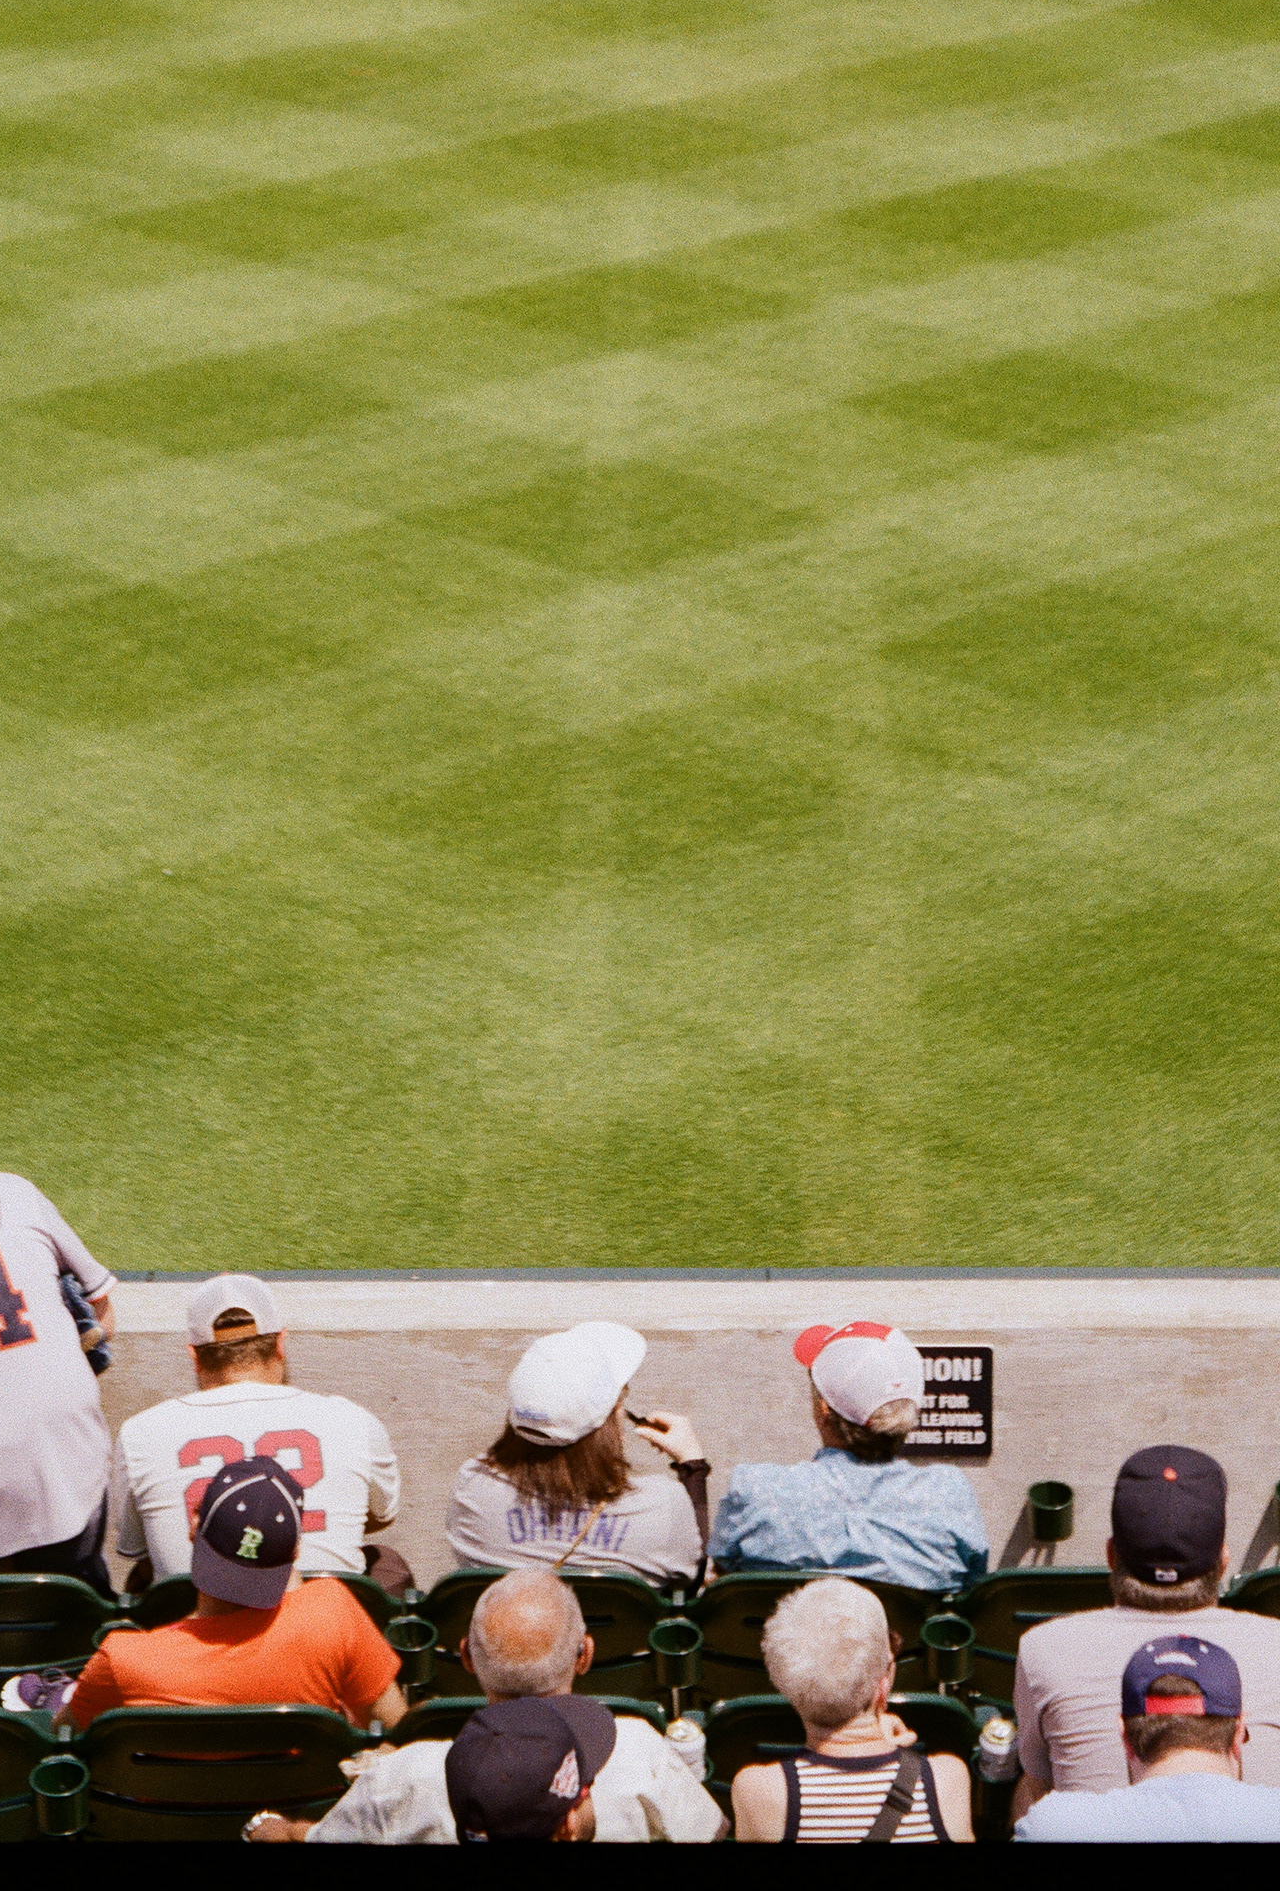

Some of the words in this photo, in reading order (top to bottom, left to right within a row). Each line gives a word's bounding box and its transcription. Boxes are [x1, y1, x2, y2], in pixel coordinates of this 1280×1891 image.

[923, 1357, 982, 1381] ION!
[921, 1413, 984, 1427] LEAVING
[944, 1431, 988, 1445] FIELD
